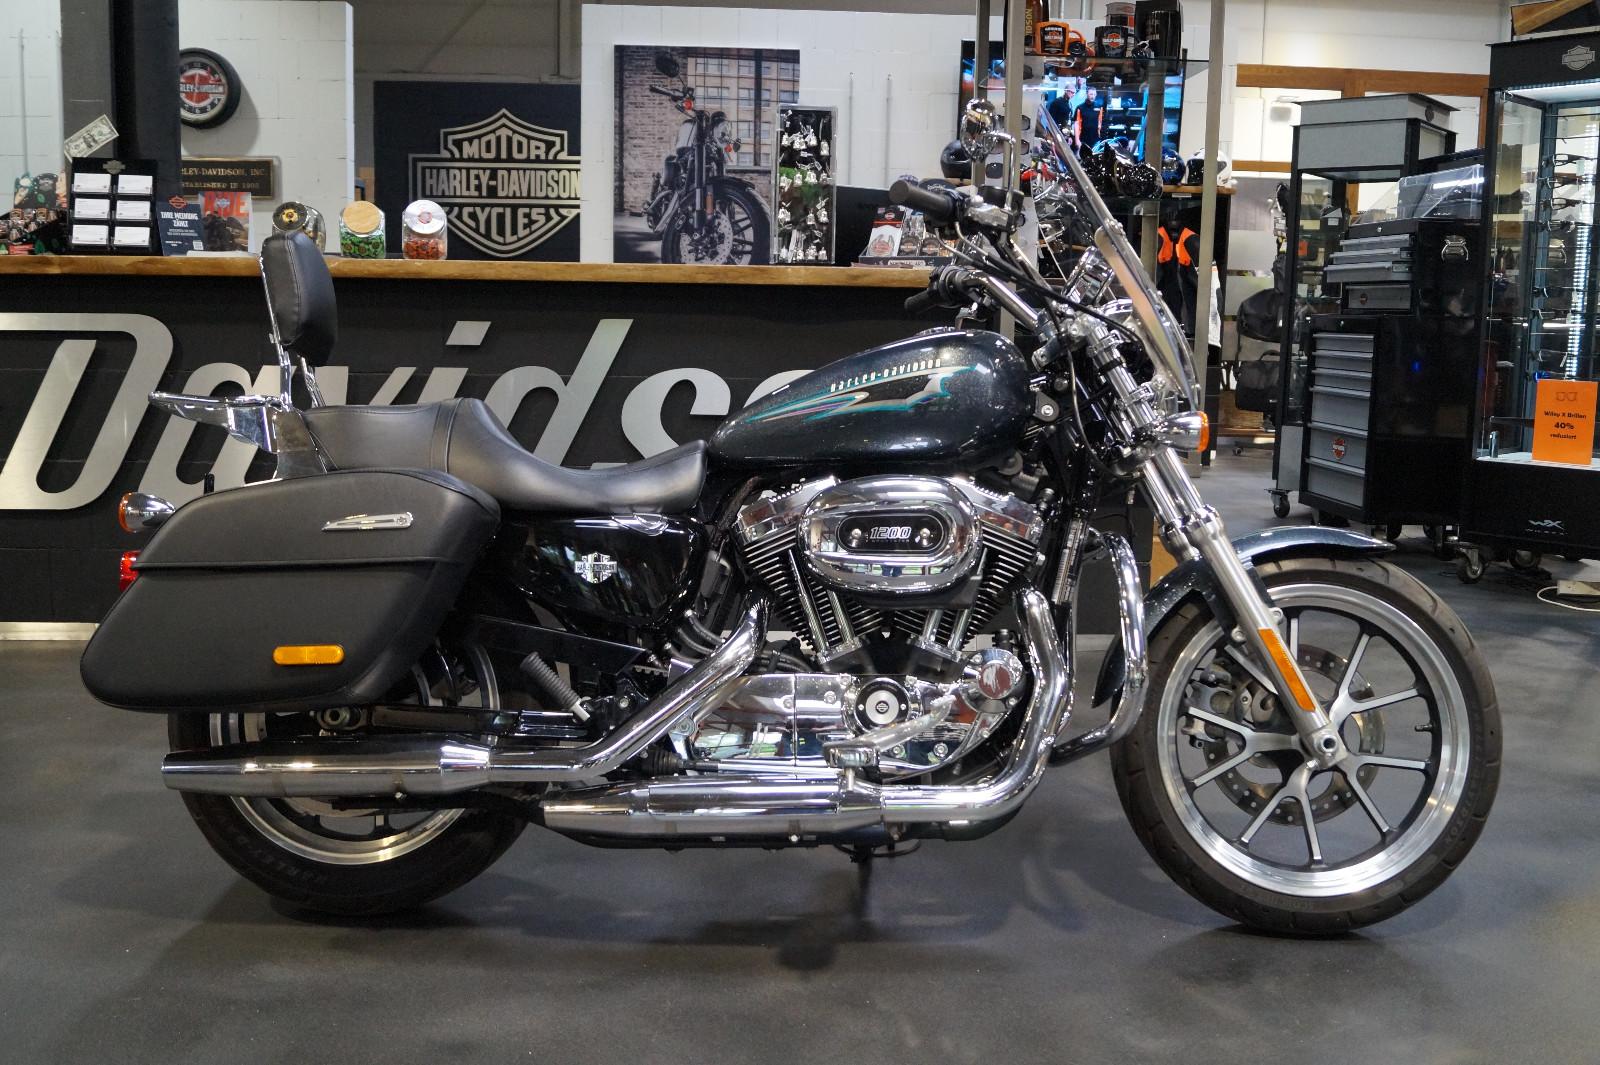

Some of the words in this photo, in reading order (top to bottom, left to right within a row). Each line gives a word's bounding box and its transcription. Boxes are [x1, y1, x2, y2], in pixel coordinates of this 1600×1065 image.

[462, 127, 546, 160] MOTOR
[425, 168, 581, 198] HARLEY-DAVIDSON
[462, 206, 547, 244] CYCLES
[1554, 421, 1575, 430] 40%
[869, 526, 912, 539] 1200
